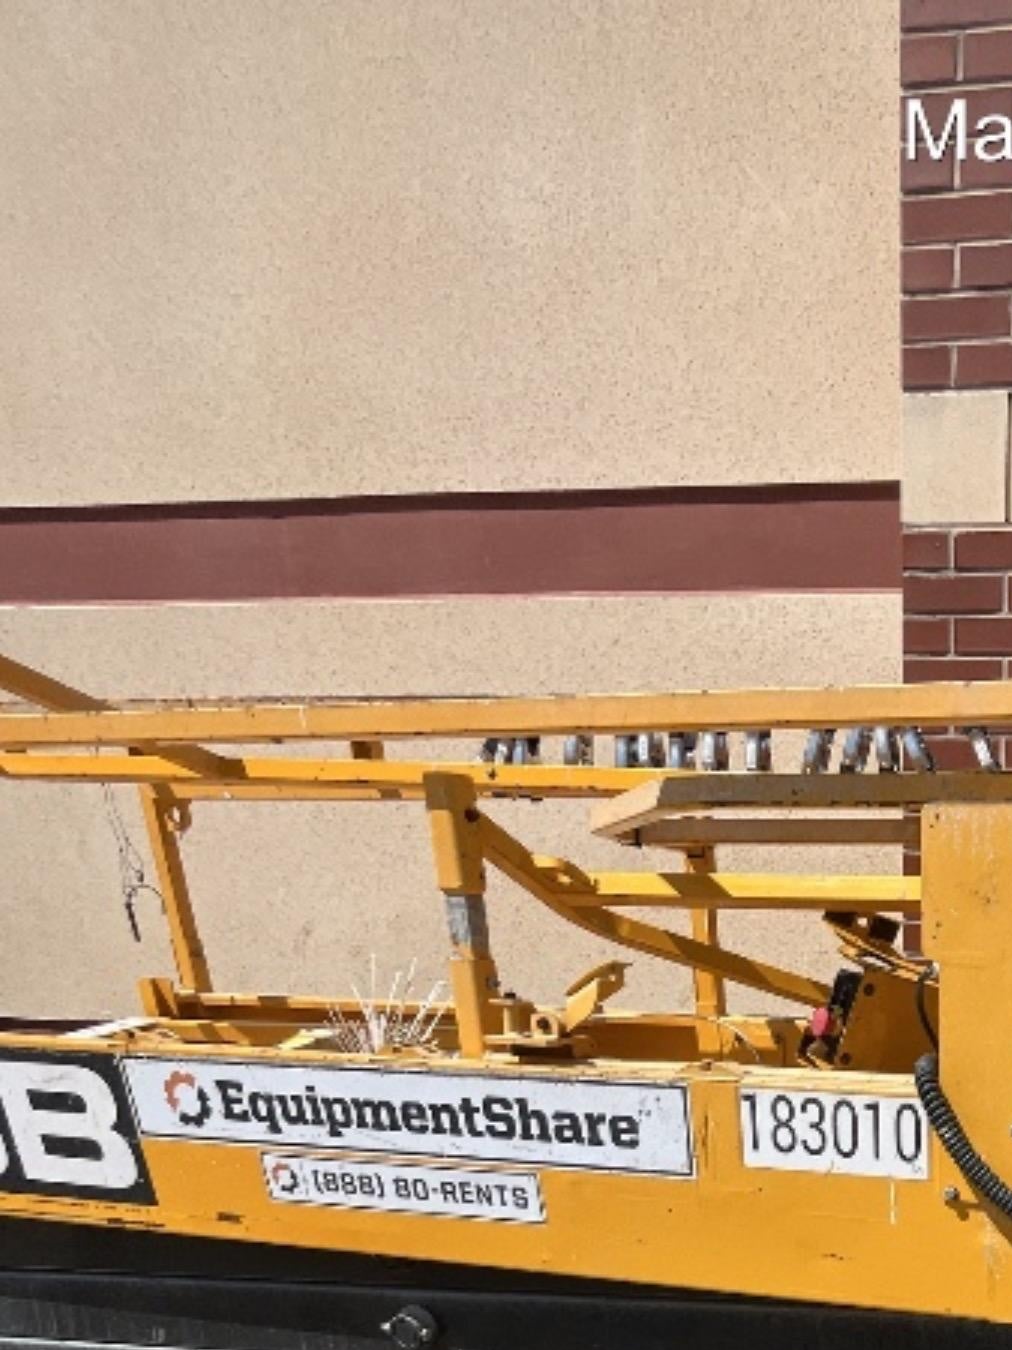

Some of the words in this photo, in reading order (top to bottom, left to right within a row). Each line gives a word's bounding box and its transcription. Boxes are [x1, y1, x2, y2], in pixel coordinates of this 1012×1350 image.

[215, 1079, 642, 1149] EquipmentShare
[742, 1094, 924, 1163] 183010
[312, 1168, 385, 1197] (888)
[394, 1176, 529, 1210] 80-RENTS
